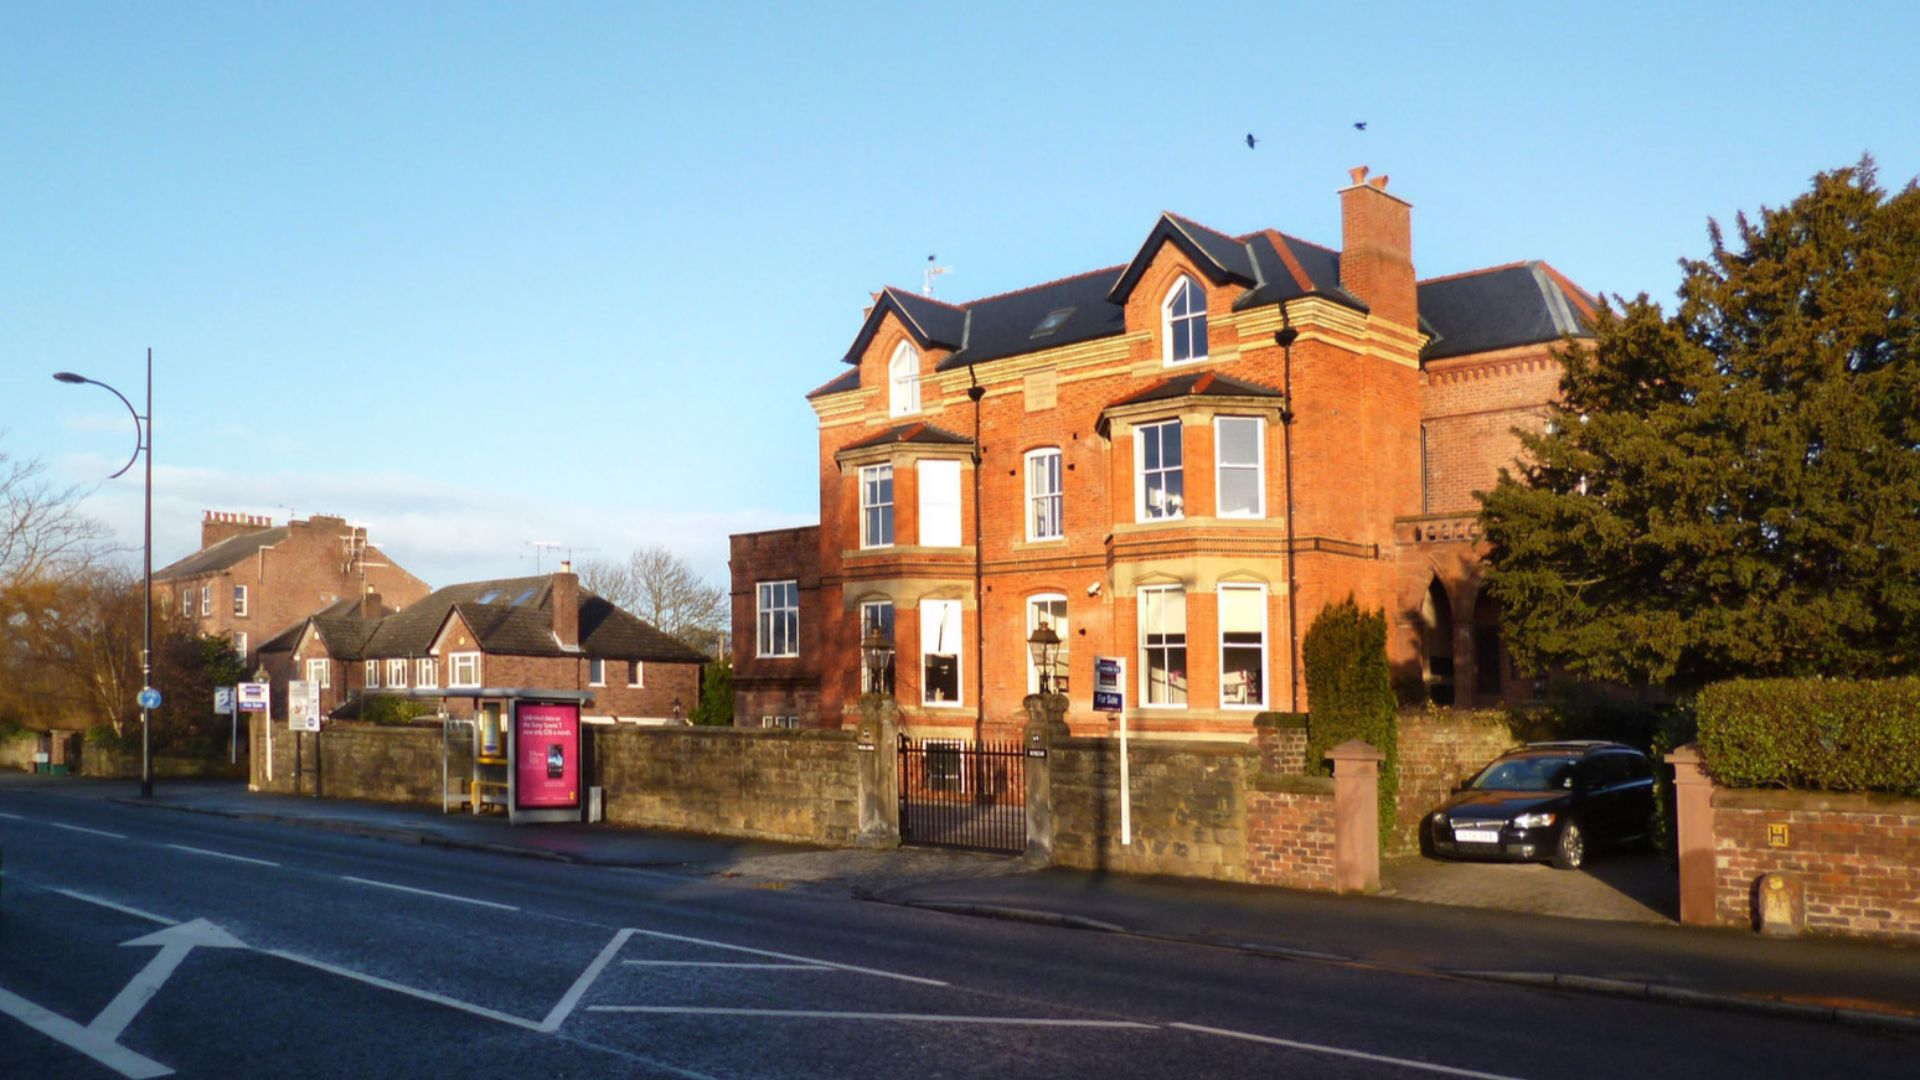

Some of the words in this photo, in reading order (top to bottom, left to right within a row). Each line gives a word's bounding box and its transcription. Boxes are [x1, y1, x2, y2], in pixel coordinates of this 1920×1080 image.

[1097, 694, 1105, 704] For
[1106, 694, 1118, 705] Sale
[1770, 826, 1785, 843] H
